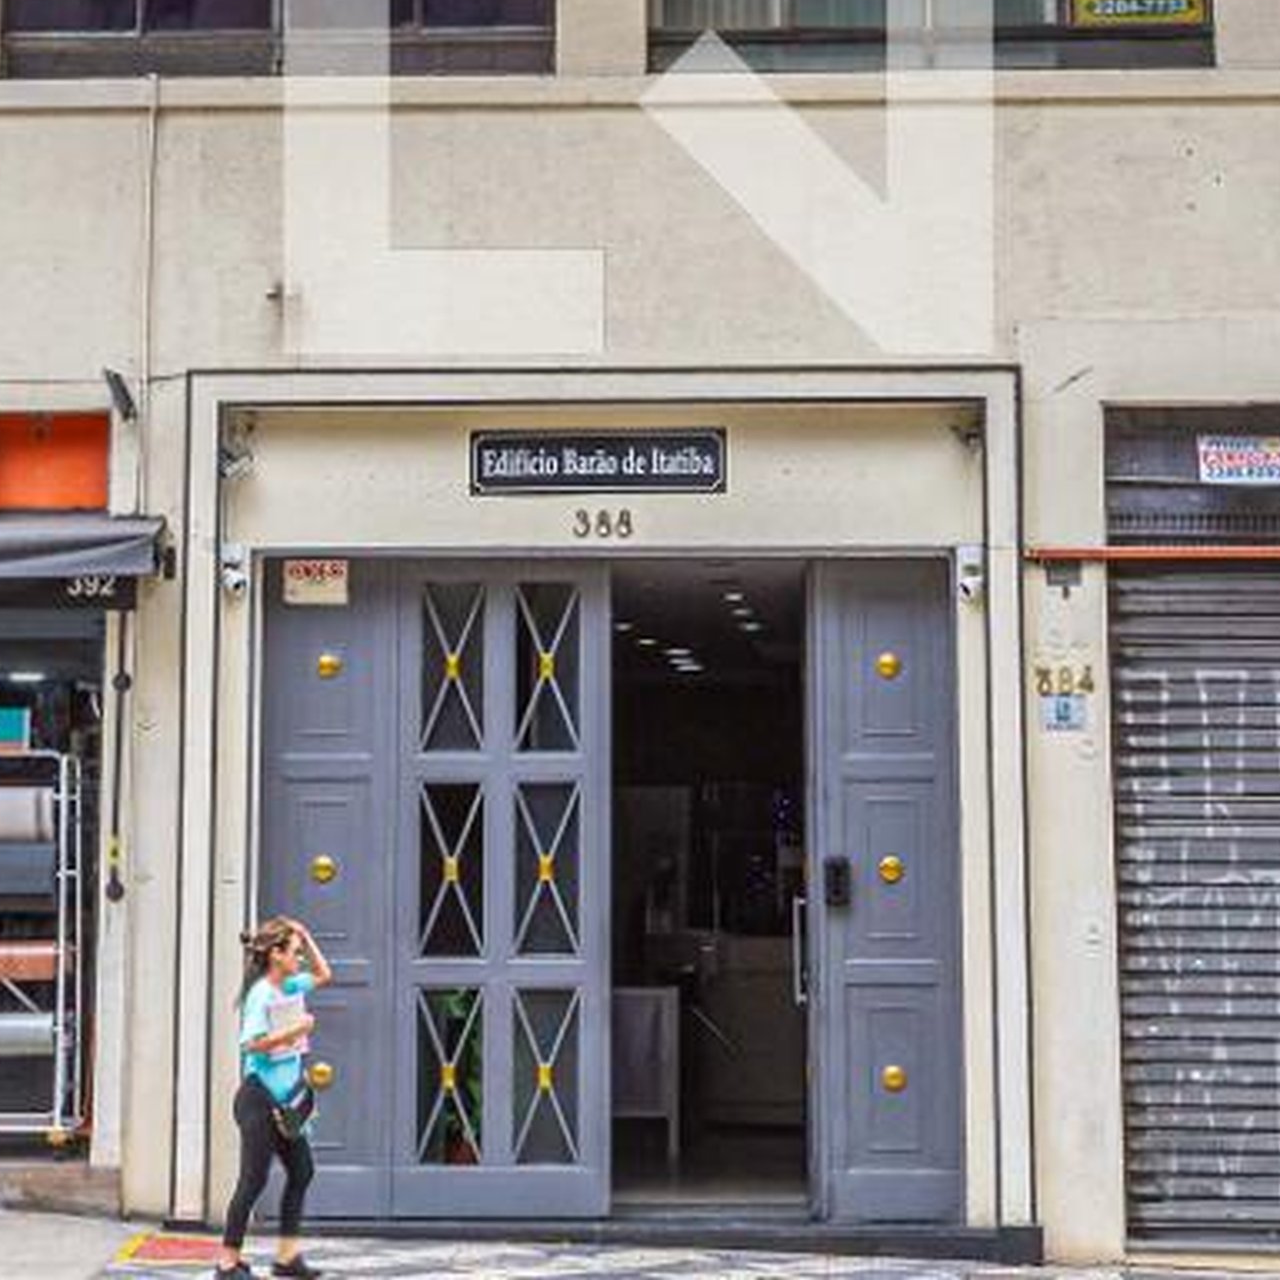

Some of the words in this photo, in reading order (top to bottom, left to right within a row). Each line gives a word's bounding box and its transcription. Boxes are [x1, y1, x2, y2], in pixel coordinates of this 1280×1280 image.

[562, 447, 618, 475] Barão
[622, 447, 647, 475] de
[651, 447, 715, 475] Itatiba
[572, 508, 633, 538] 388
[66, 572, 116, 598] 392
